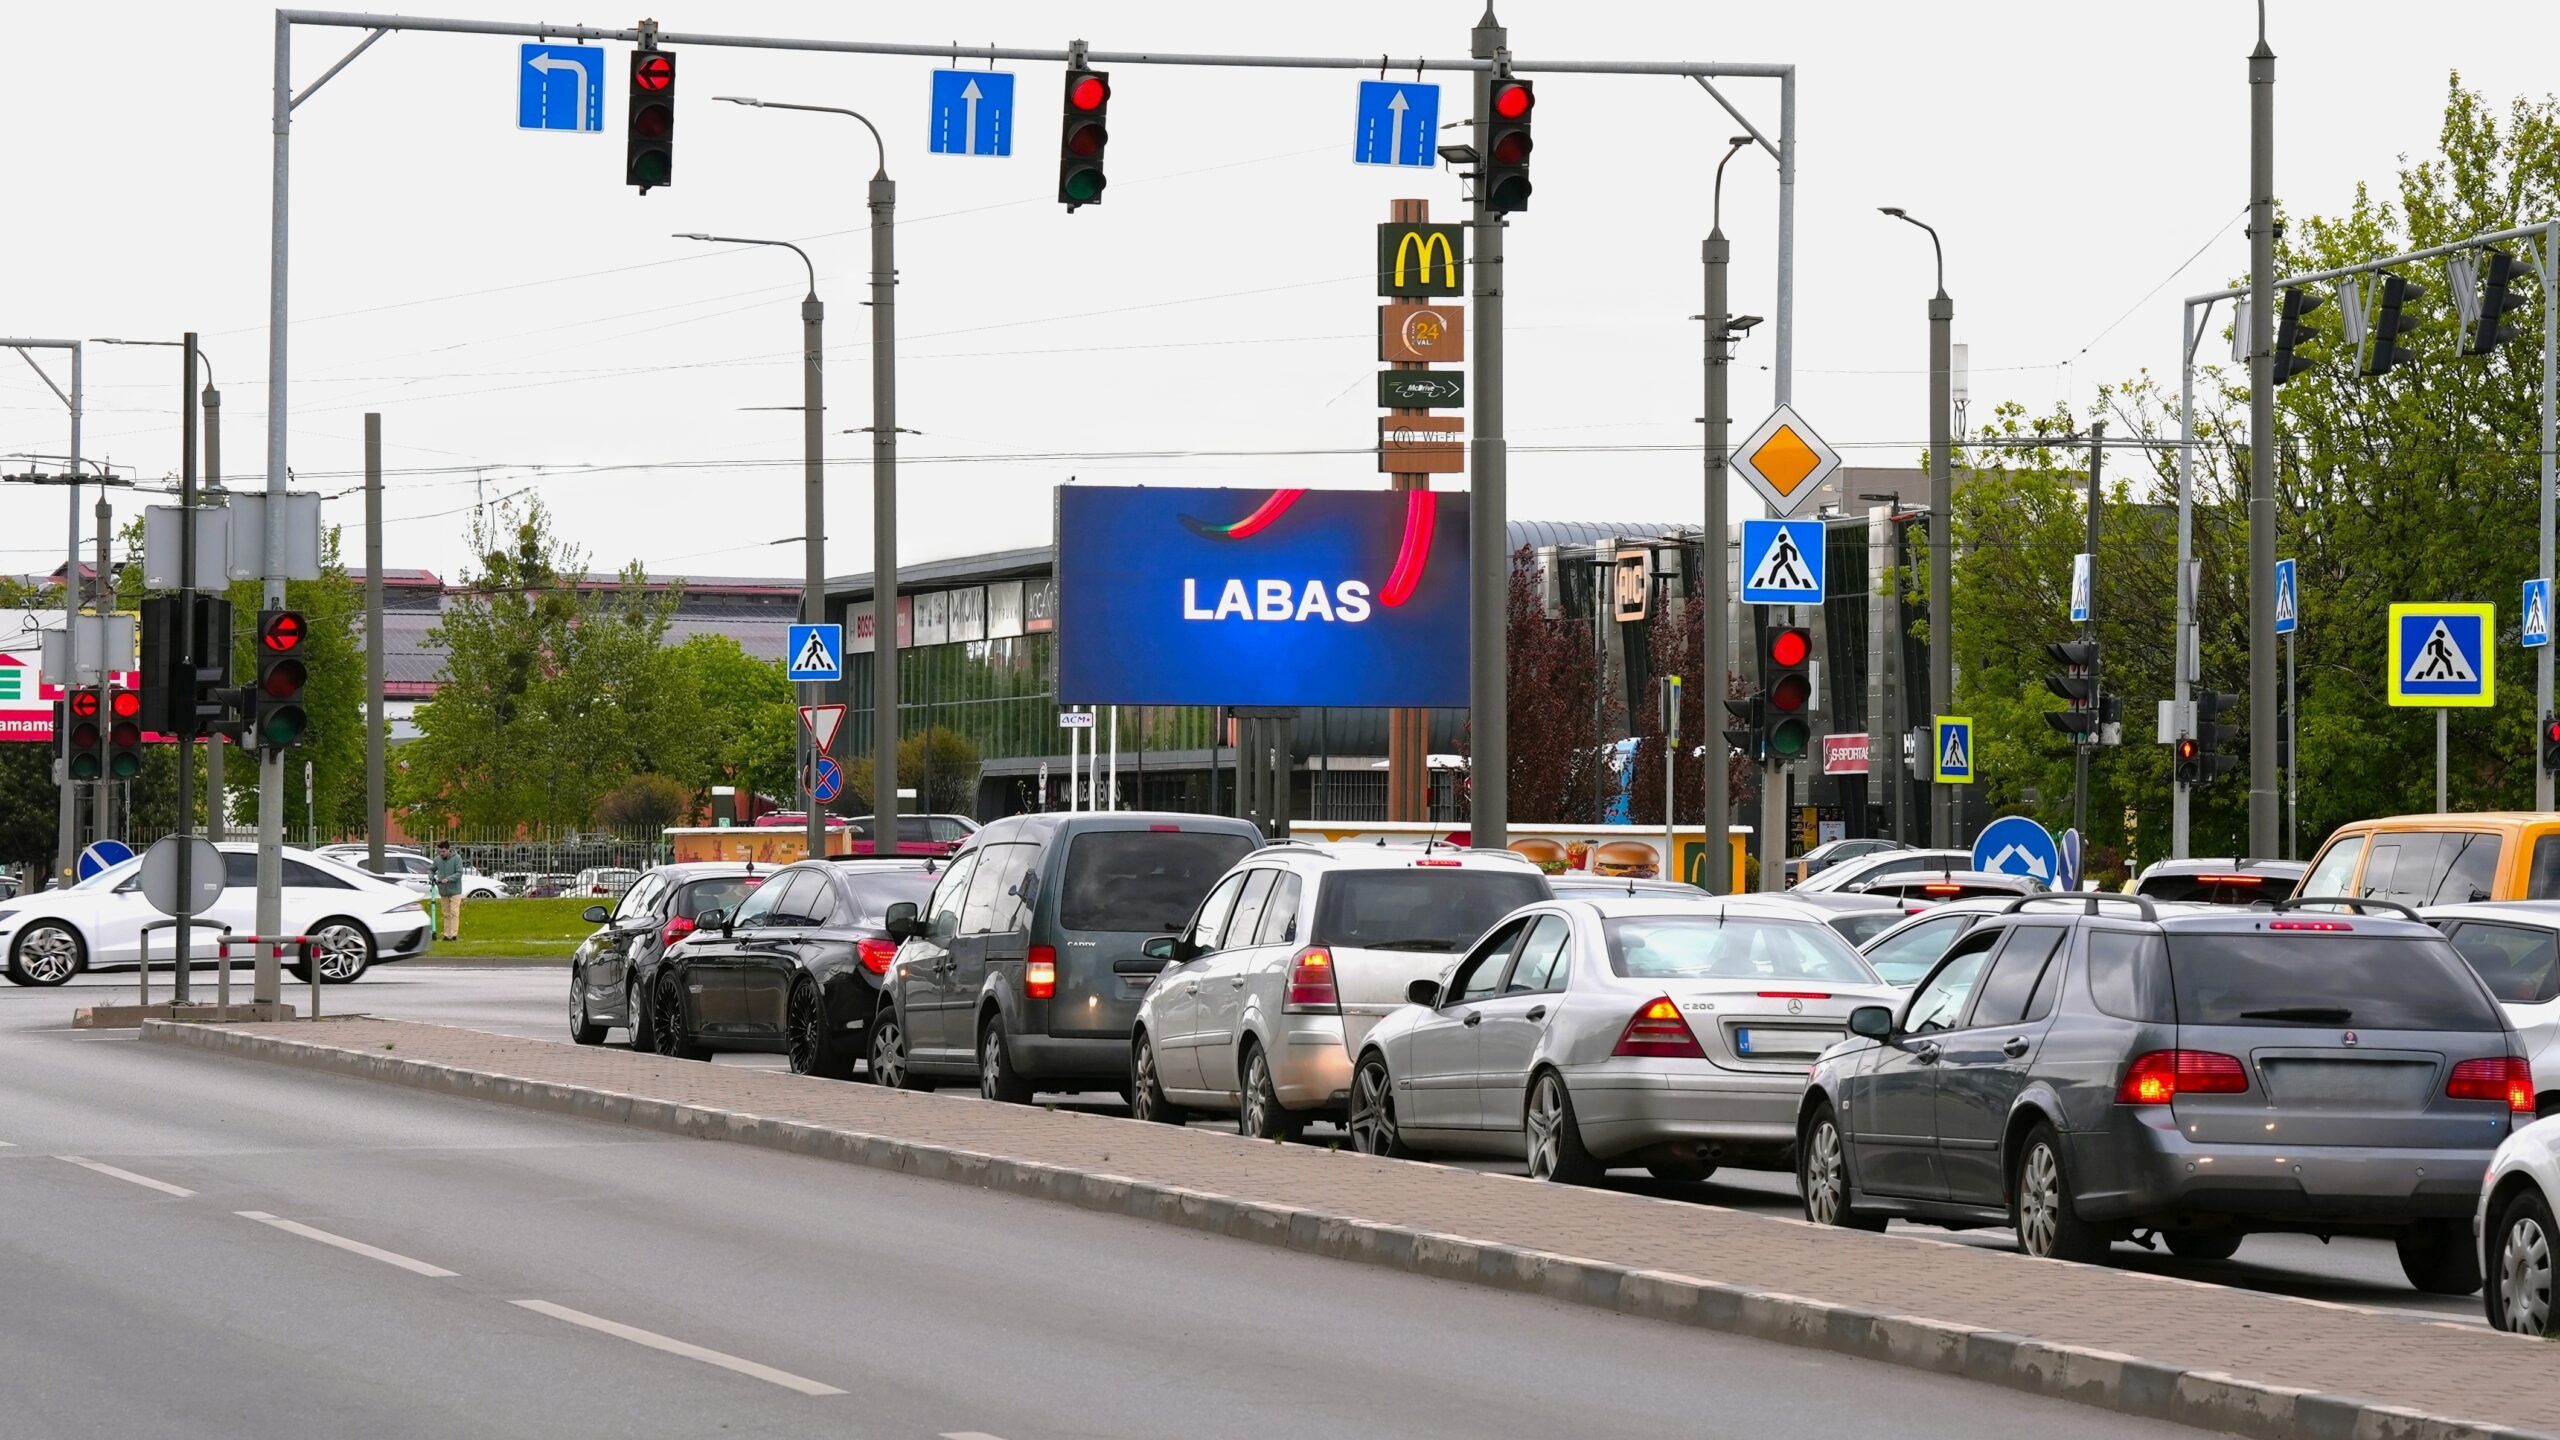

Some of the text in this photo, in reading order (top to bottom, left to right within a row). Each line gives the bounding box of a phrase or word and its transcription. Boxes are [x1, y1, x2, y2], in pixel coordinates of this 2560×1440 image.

[1416, 322, 1440, 340] 24
[1407, 384, 1436, 392] McDrive
[1183, 578, 1371, 623] LABAS
